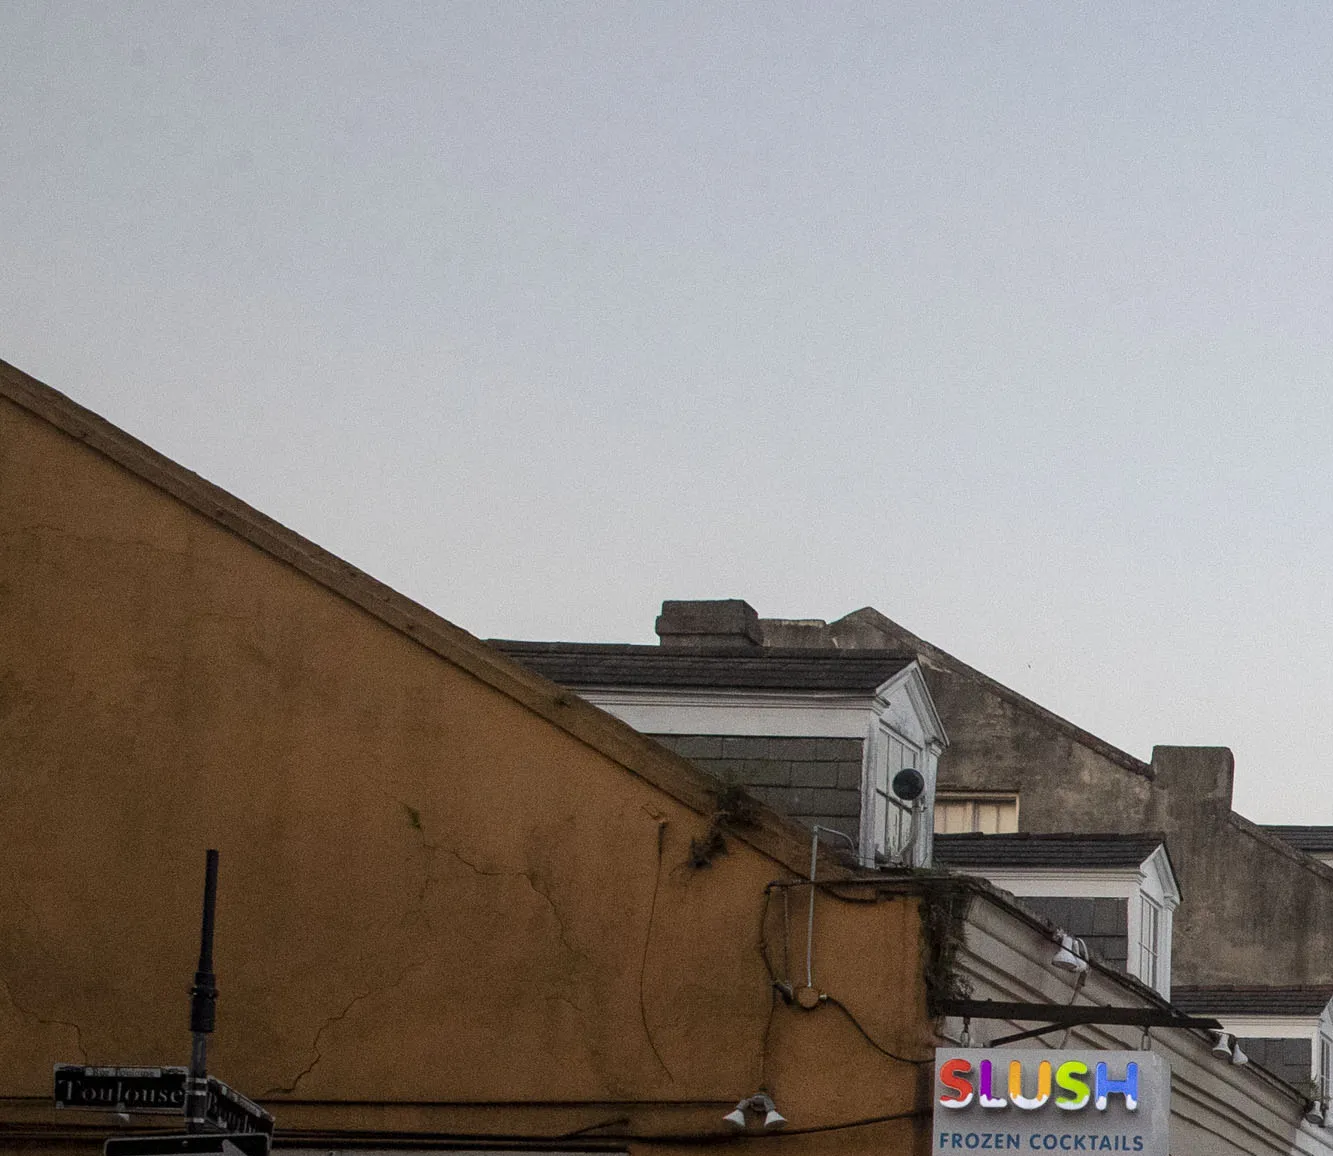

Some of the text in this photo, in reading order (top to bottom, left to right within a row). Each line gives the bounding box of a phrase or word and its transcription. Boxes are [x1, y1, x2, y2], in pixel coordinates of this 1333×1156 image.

[58, 1079, 184, 1103] Toulouse
[939, 1058, 1138, 1110] SLUSH
[939, 1132, 1144, 1151] FROZEN COCKTAILS
